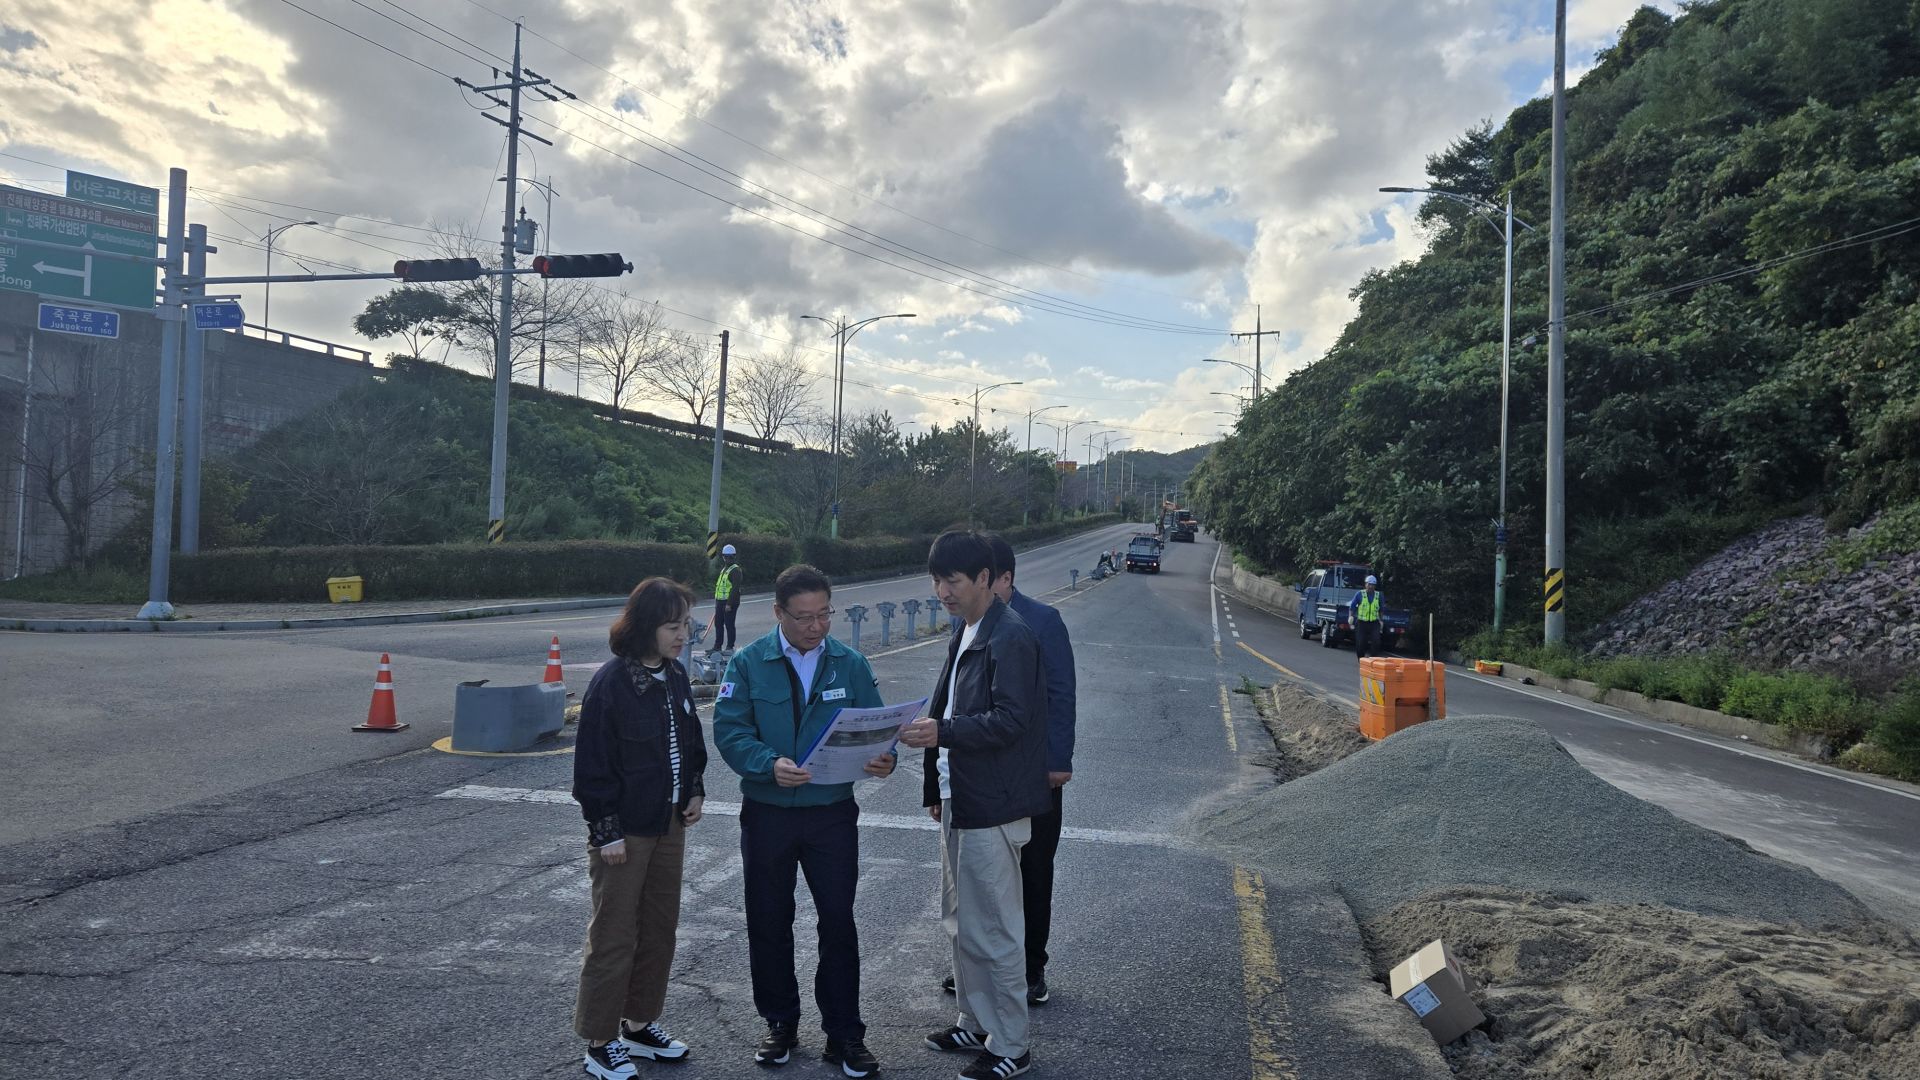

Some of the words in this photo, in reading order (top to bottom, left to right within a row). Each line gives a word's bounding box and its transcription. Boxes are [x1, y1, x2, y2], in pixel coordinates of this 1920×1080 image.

[74, 180, 153, 206] 어은교차로
[7, 194, 57, 214] 진해해양공원
[27, 214, 87, 238] 진해국가산업단지
[52, 308, 93, 323] 죽곡로
[196, 306, 222, 319] 어은로
[50, 320, 93, 333] Jukgok-ro
